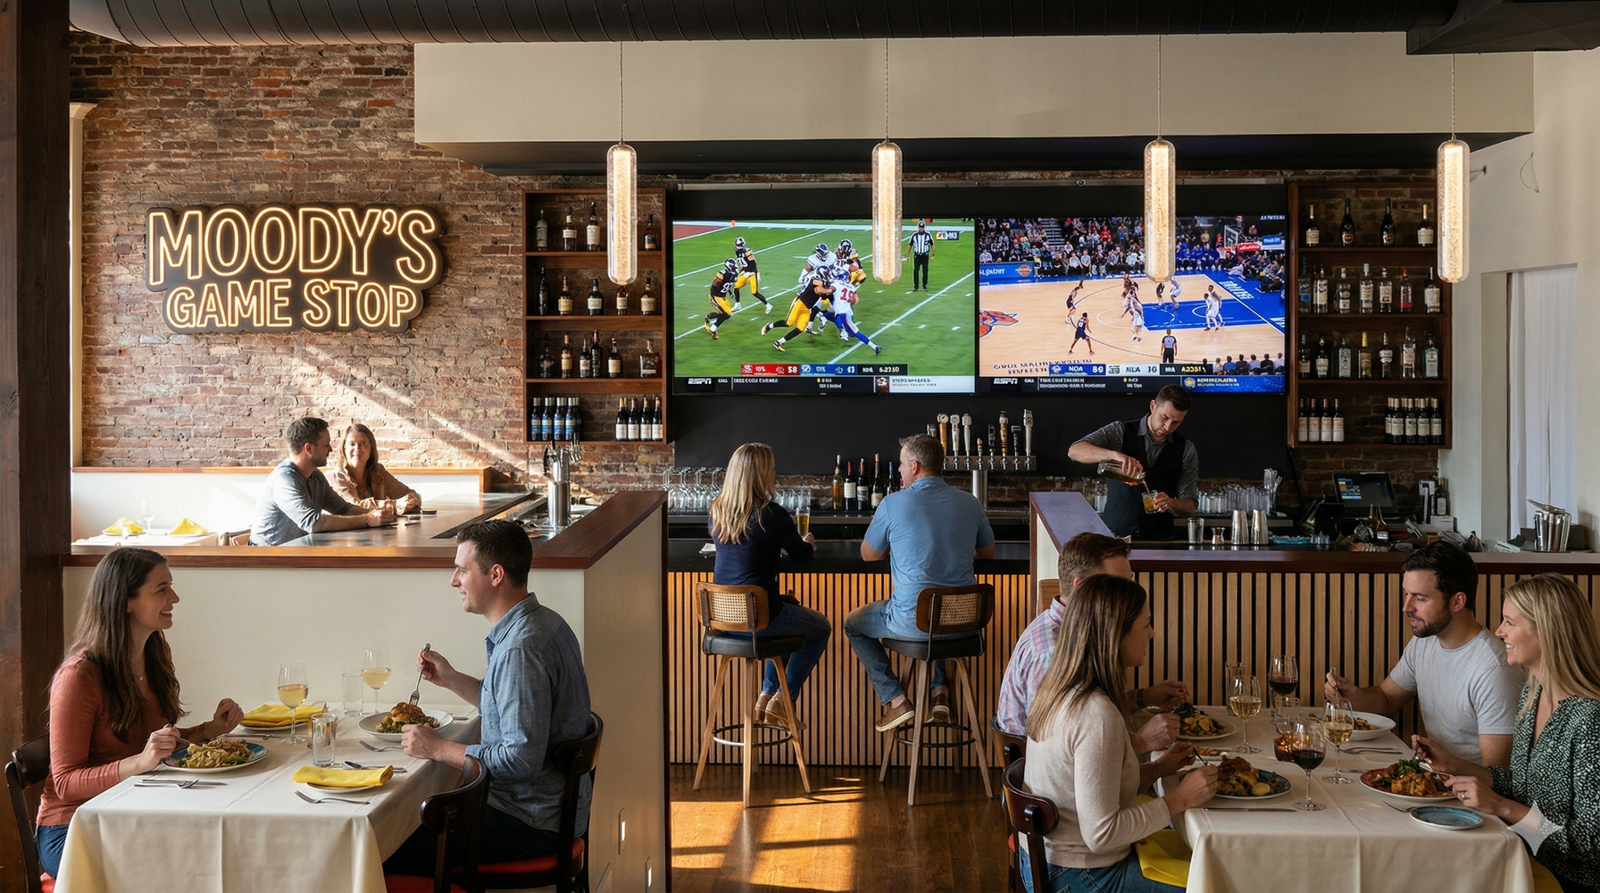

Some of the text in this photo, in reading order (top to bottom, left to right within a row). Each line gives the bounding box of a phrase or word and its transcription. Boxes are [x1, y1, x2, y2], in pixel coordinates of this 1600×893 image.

[148, 207, 437, 286] MOODY'S
[165, 278, 417, 328] GAME STOP
